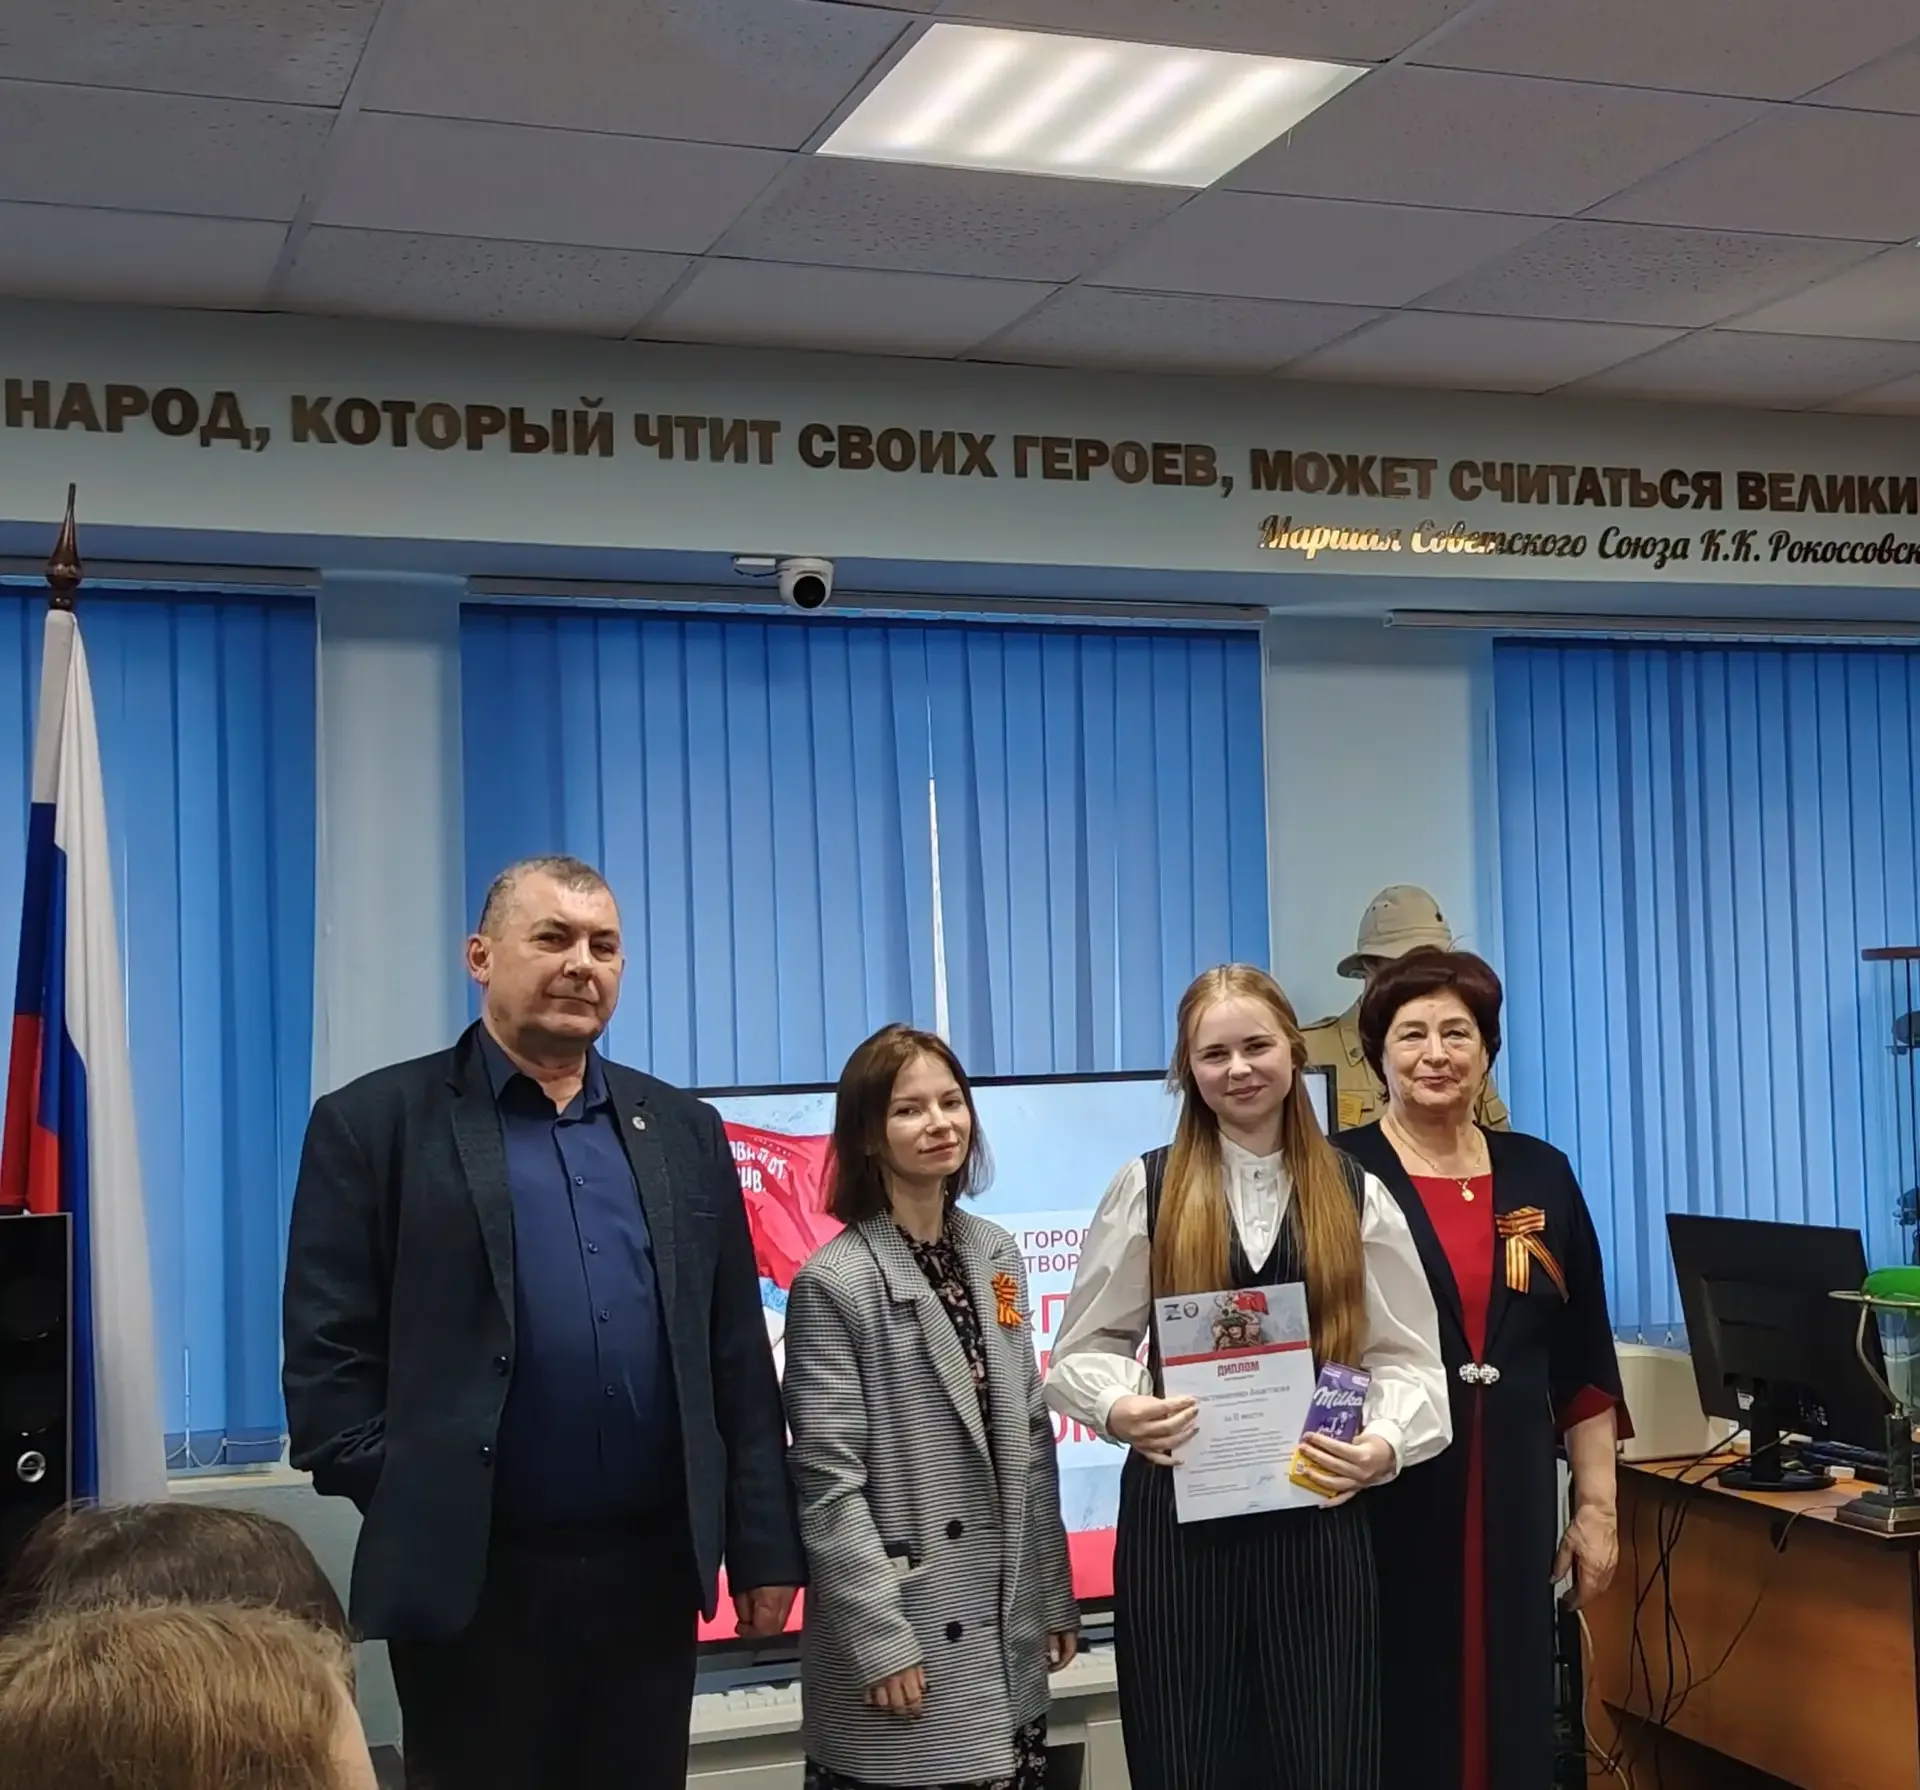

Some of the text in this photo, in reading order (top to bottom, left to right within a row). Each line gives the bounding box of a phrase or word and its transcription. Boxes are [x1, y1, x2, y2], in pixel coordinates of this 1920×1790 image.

[4, 379, 270, 452] НАРОД,
[291, 395, 614, 457] КОТОРЫЙ
[634, 413, 781, 465] ЧТИТ
[799, 423, 998, 478] СВОИХ
[1013, 435, 1234, 498] ГЕРОЕВ,
[1250, 449, 1437, 499] МОЖЕТ
[1449, 460, 1722, 511] СЧИТАТЬСЯ
[1259, 514, 1402, 560] Маршал
[1411, 518, 1587, 558] Советского
[1598, 525, 1691, 569] Союза
[1700, 528, 1760, 563] К.К.
[1217, 1360, 1260, 1377] ДИПЛОМ
[1313, 1386, 1364, 1409] Milka
